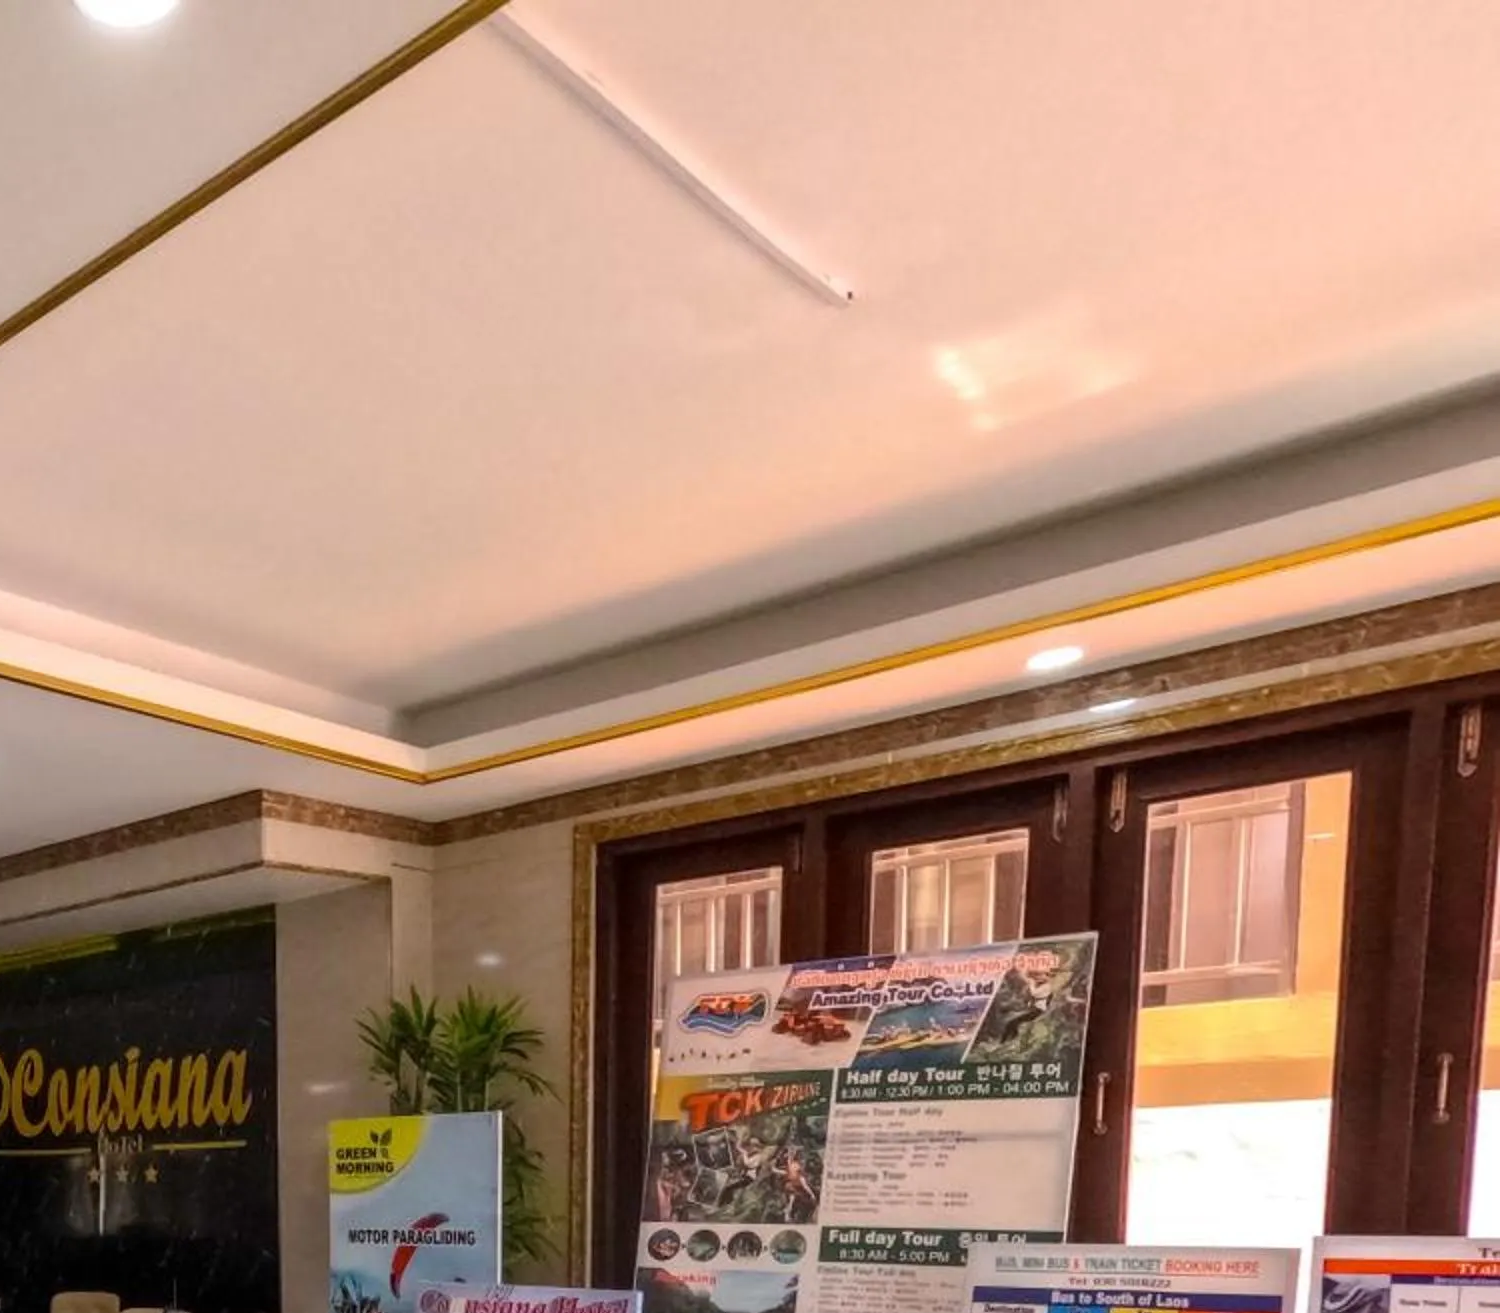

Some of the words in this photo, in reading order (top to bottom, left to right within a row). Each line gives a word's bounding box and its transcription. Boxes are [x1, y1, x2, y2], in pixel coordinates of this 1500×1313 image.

[812, 988, 882, 1006] Amazing
[887, 986, 925, 1001] Tour
[847, 1069, 882, 1084] Half
[888, 1068, 919, 1086] day
[924, 1067, 964, 1082] Tour
[967, 1083, 991, 1095] PM
[1045, 1081, 1070, 1093] PM
[684, 1087, 766, 1134] TCK
[336, 1147, 377, 1160] GREEN
[336, 1161, 394, 1174] MORNING
[348, 1229, 389, 1244] MOTOR
[392, 1229, 476, 1246] PARAGLIDING
[829, 1229, 860, 1244] Full
[865, 1231, 897, 1249] day
[901, 1231, 943, 1246] Tour
[867, 1249, 888, 1261] AM
[929, 1251, 950, 1263] PM
[1085, 1258, 1118, 1269] TRAIN
[1121, 1259, 1161, 1270] TICKET
[1166, 1259, 1221, 1273] BOOKING
[1225, 1261, 1260, 1274] HERE
[1051, 1290, 1075, 1303] Bus
[1078, 1291, 1092, 1304] to
[1095, 1291, 1134, 1306] South
[1138, 1292, 1153, 1307] of
[1156, 1294, 1190, 1308] Laos
